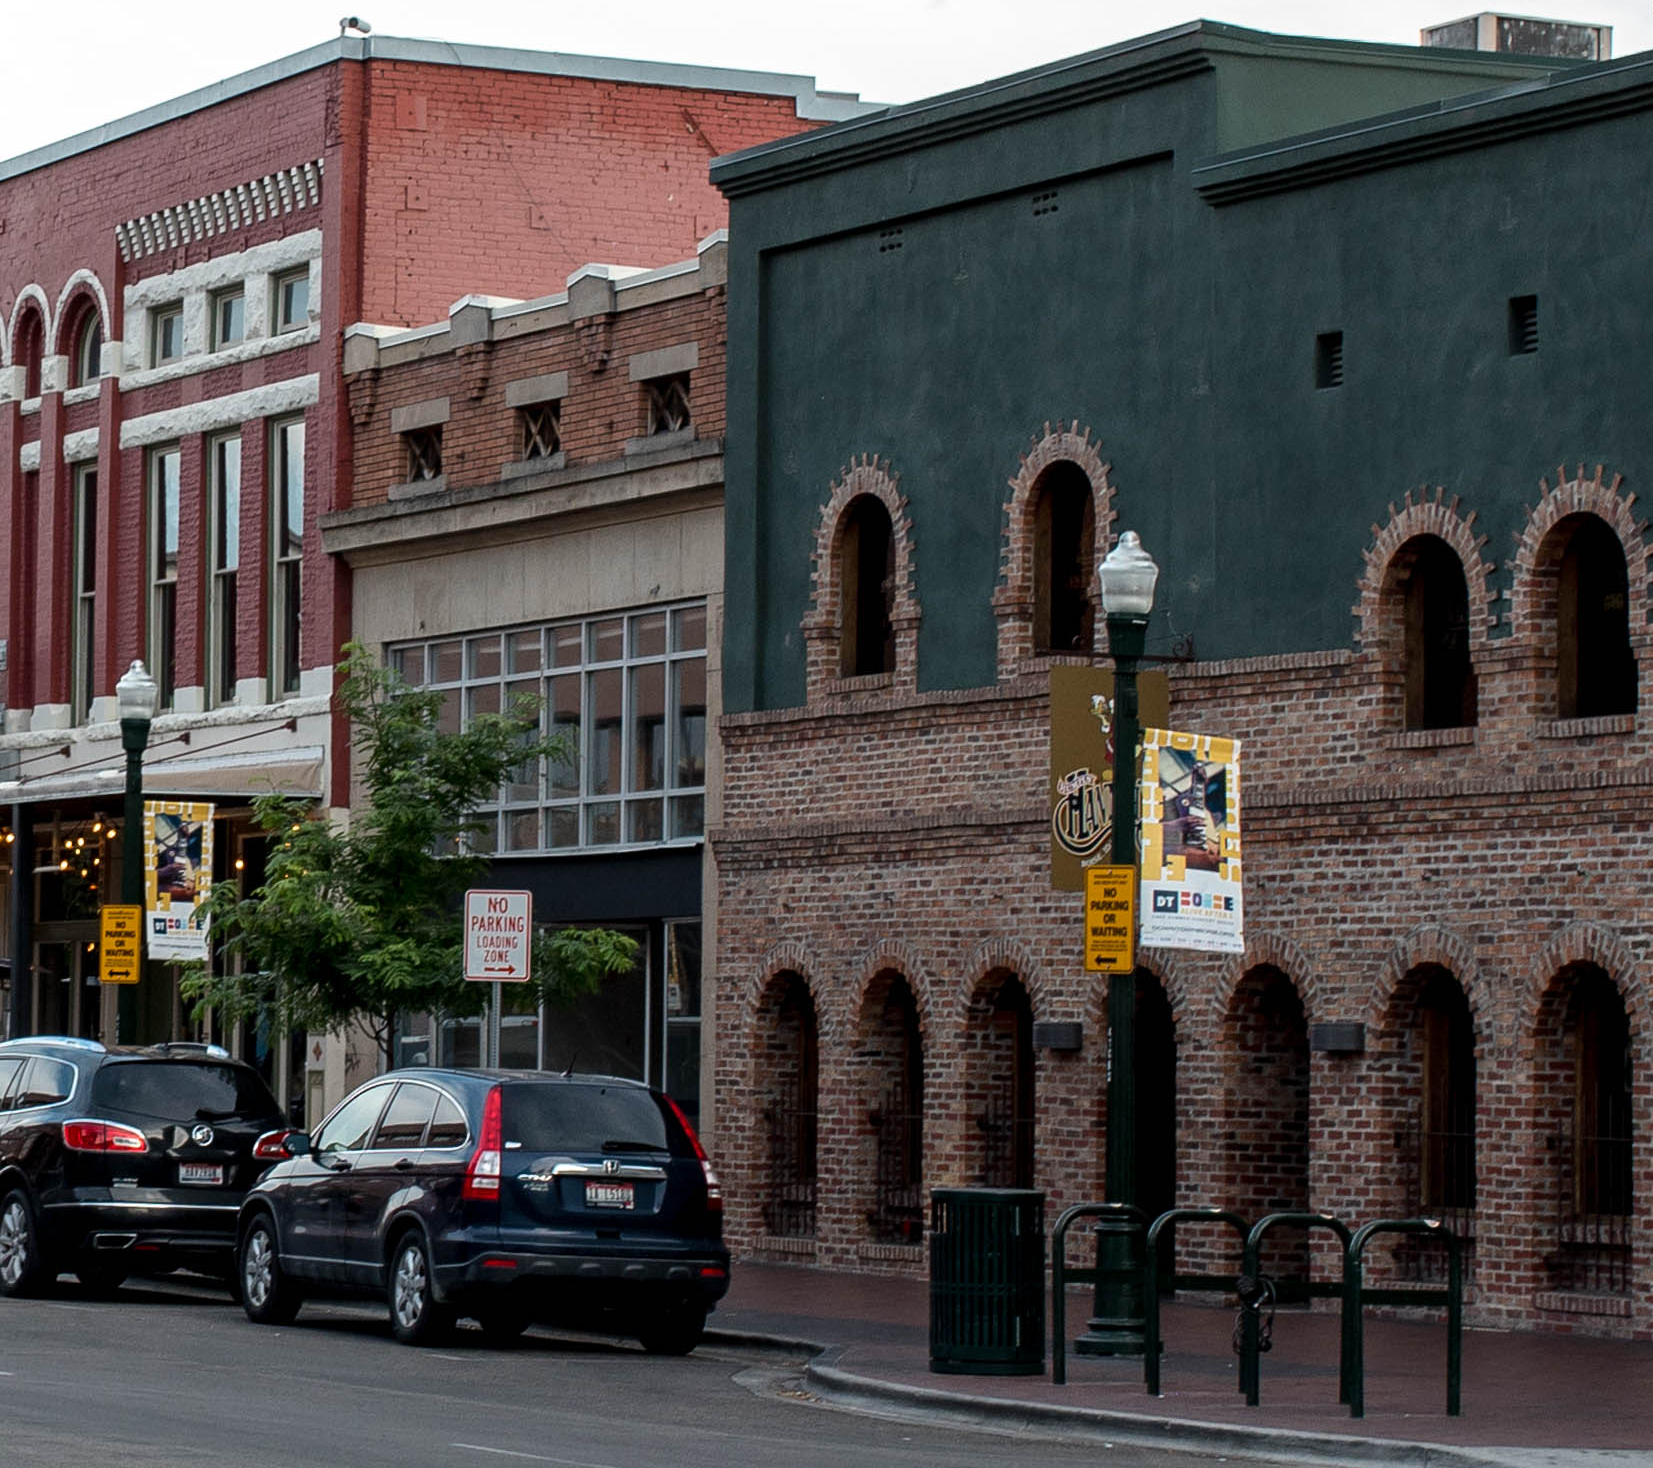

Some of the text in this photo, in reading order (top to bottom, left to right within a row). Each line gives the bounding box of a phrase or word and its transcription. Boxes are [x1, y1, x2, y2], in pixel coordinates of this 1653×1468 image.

[1103, 888, 1117, 898] NO
[488, 896, 508, 914] NO
[1090, 900, 1129, 911] PARKING
[1157, 891, 1234, 911] DT BOISE
[1103, 913, 1116, 923] OR
[115, 921, 127, 929] NO
[471, 915, 525, 933] PARKING
[1091, 926, 1128, 937] WAITING
[476, 935, 518, 949] LOADING
[105, 949, 134, 957] WAITING
[483, 949, 510, 963] ZONE
